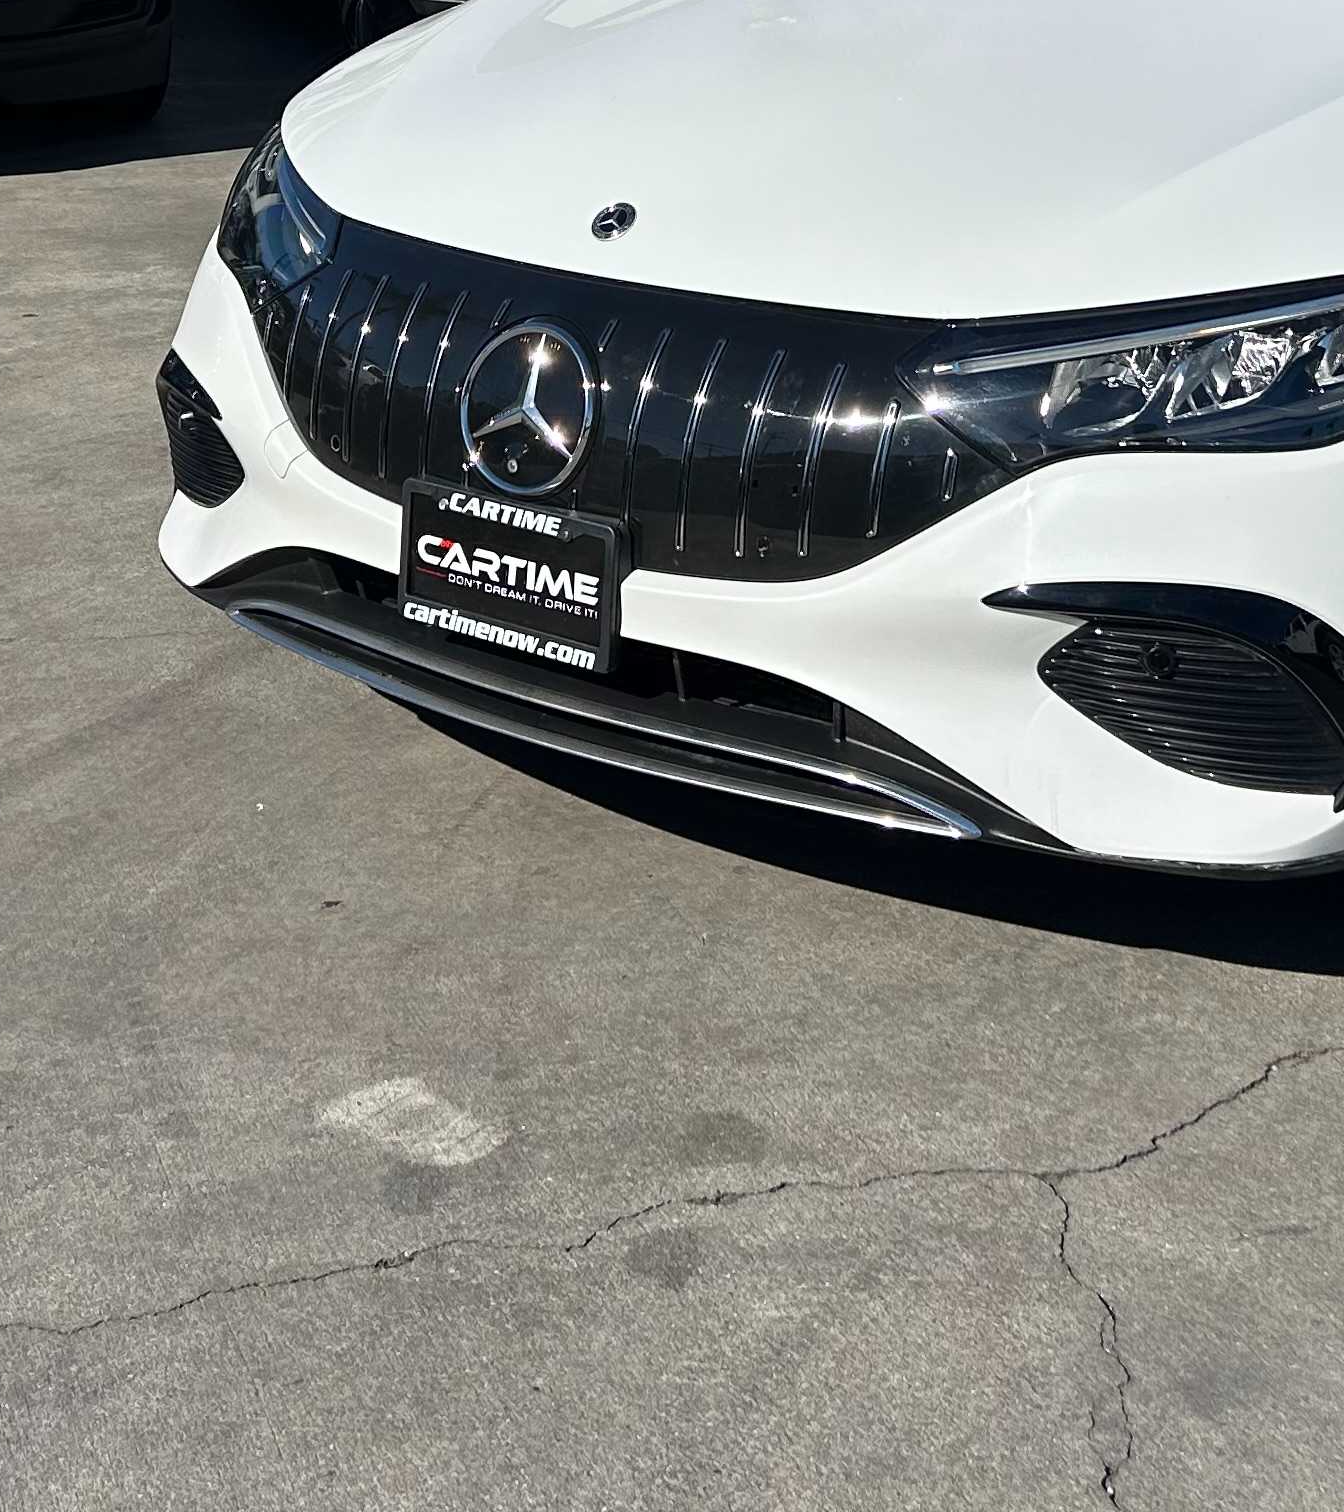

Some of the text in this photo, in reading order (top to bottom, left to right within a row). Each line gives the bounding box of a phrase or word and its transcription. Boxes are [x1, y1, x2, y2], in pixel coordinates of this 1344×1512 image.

[449, 492, 562, 537] CARTIME
[417, 534, 600, 606] CARTIME
[448, 573, 481, 590] DON'T
[484, 583, 526, 601] DREAM
[545, 599, 582, 615] DRIVE
[584, 607, 599, 620] IT!
[403, 601, 596, 671] cartimenow.com
